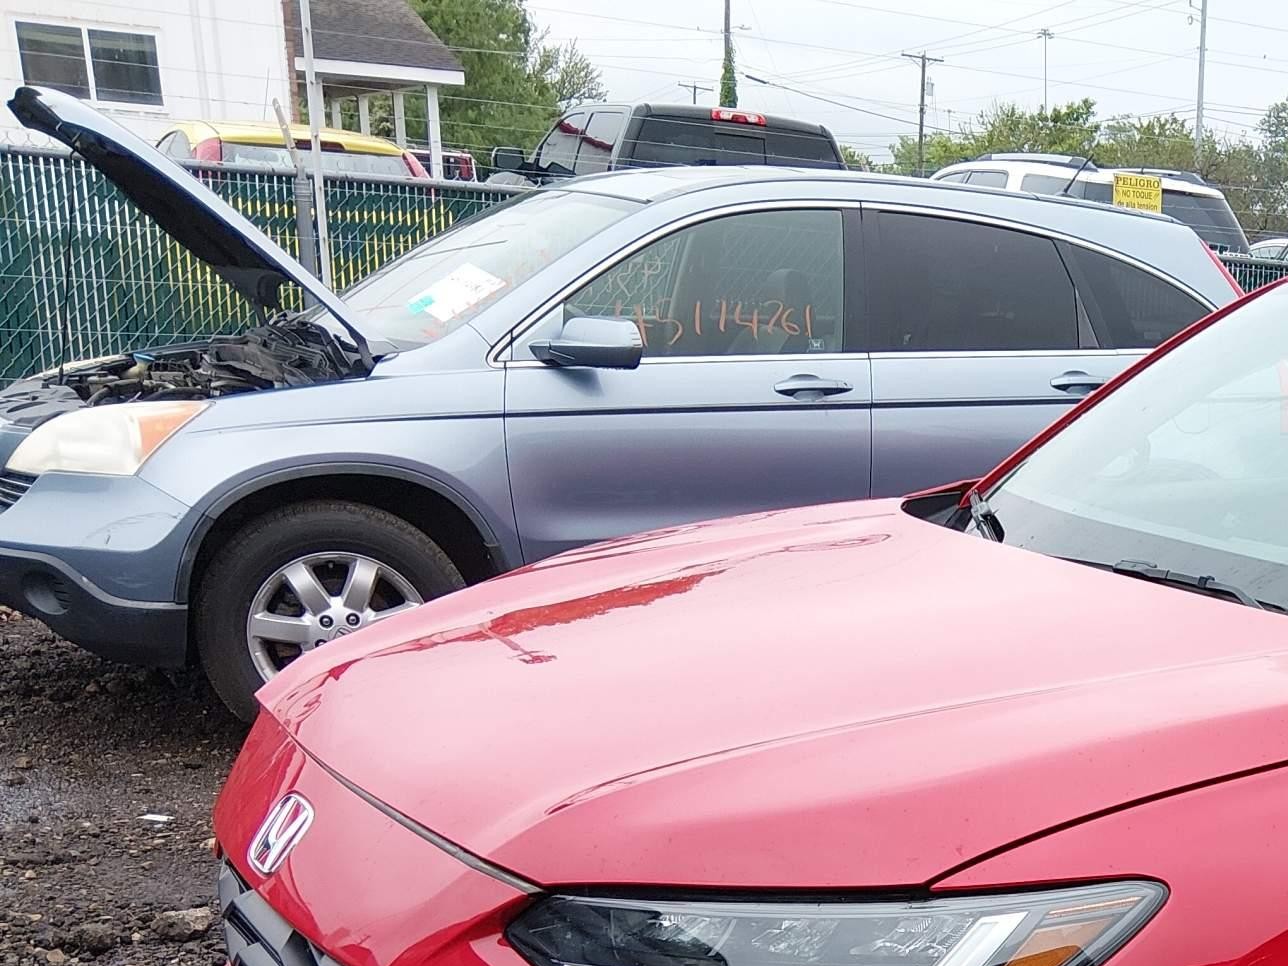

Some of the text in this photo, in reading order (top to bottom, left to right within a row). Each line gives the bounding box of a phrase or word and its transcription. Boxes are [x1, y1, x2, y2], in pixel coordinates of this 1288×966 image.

[1115, 176, 1160, 189] PELIGRO
[1121, 189, 1153, 200] NO TOQUE
